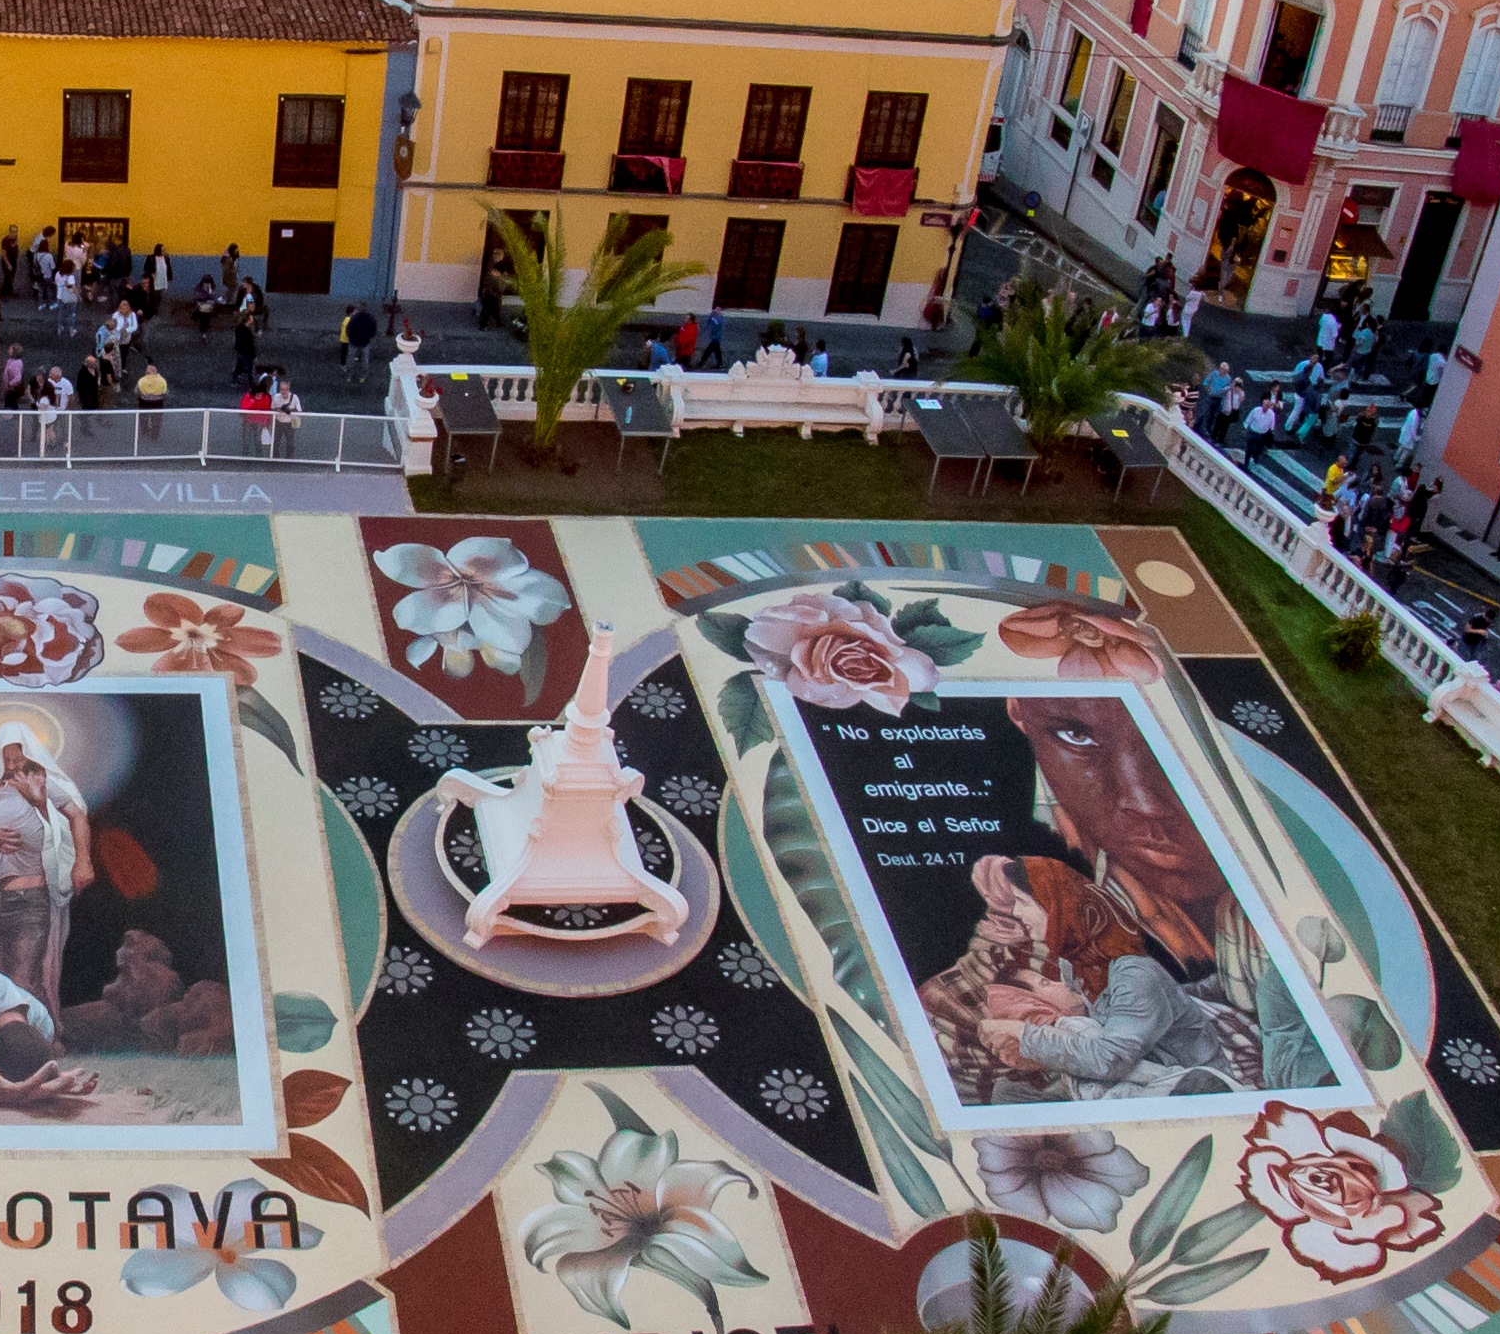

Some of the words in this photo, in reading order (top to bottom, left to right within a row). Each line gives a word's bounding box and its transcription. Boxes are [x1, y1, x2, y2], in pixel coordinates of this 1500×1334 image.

[141, 482, 273, 504] VILLA
[880, 724, 987, 744] explotarás
[893, 753, 914, 769] al
[862, 817, 908, 834] Dice
[917, 817, 937, 833] el
[944, 817, 1001, 833] Señor
[877, 853, 920, 867] Deut.
[922, 852, 965, 865] 24.17
